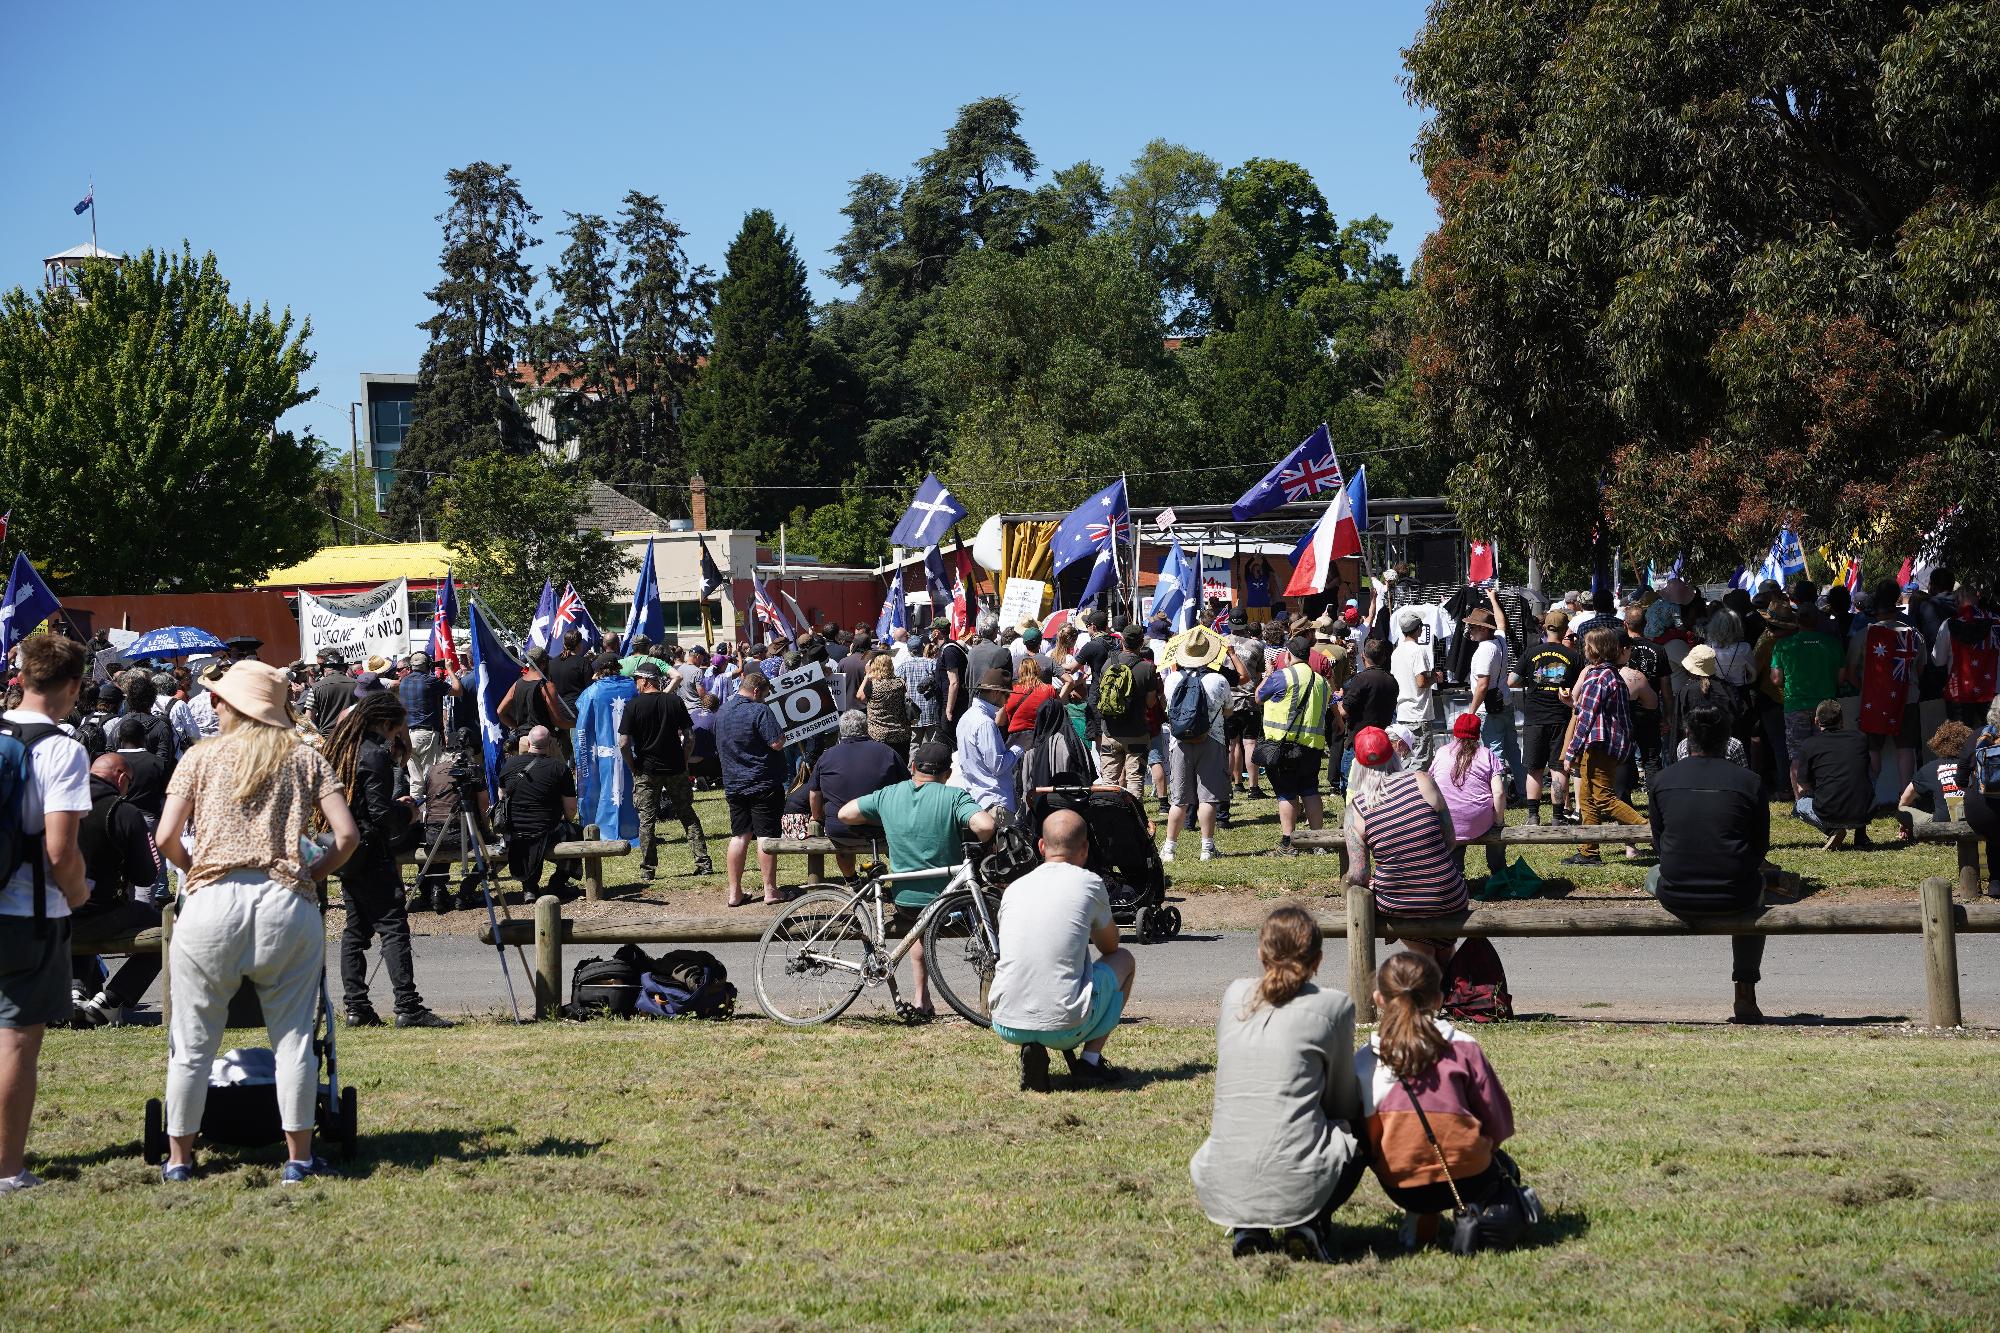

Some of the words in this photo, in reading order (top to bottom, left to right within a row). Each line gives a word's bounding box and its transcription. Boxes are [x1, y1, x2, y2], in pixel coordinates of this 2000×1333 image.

[1203, 590, 1227, 598] CCESS
[780, 669, 814, 690] Say
[801, 714, 838, 735] PASSPORTS
